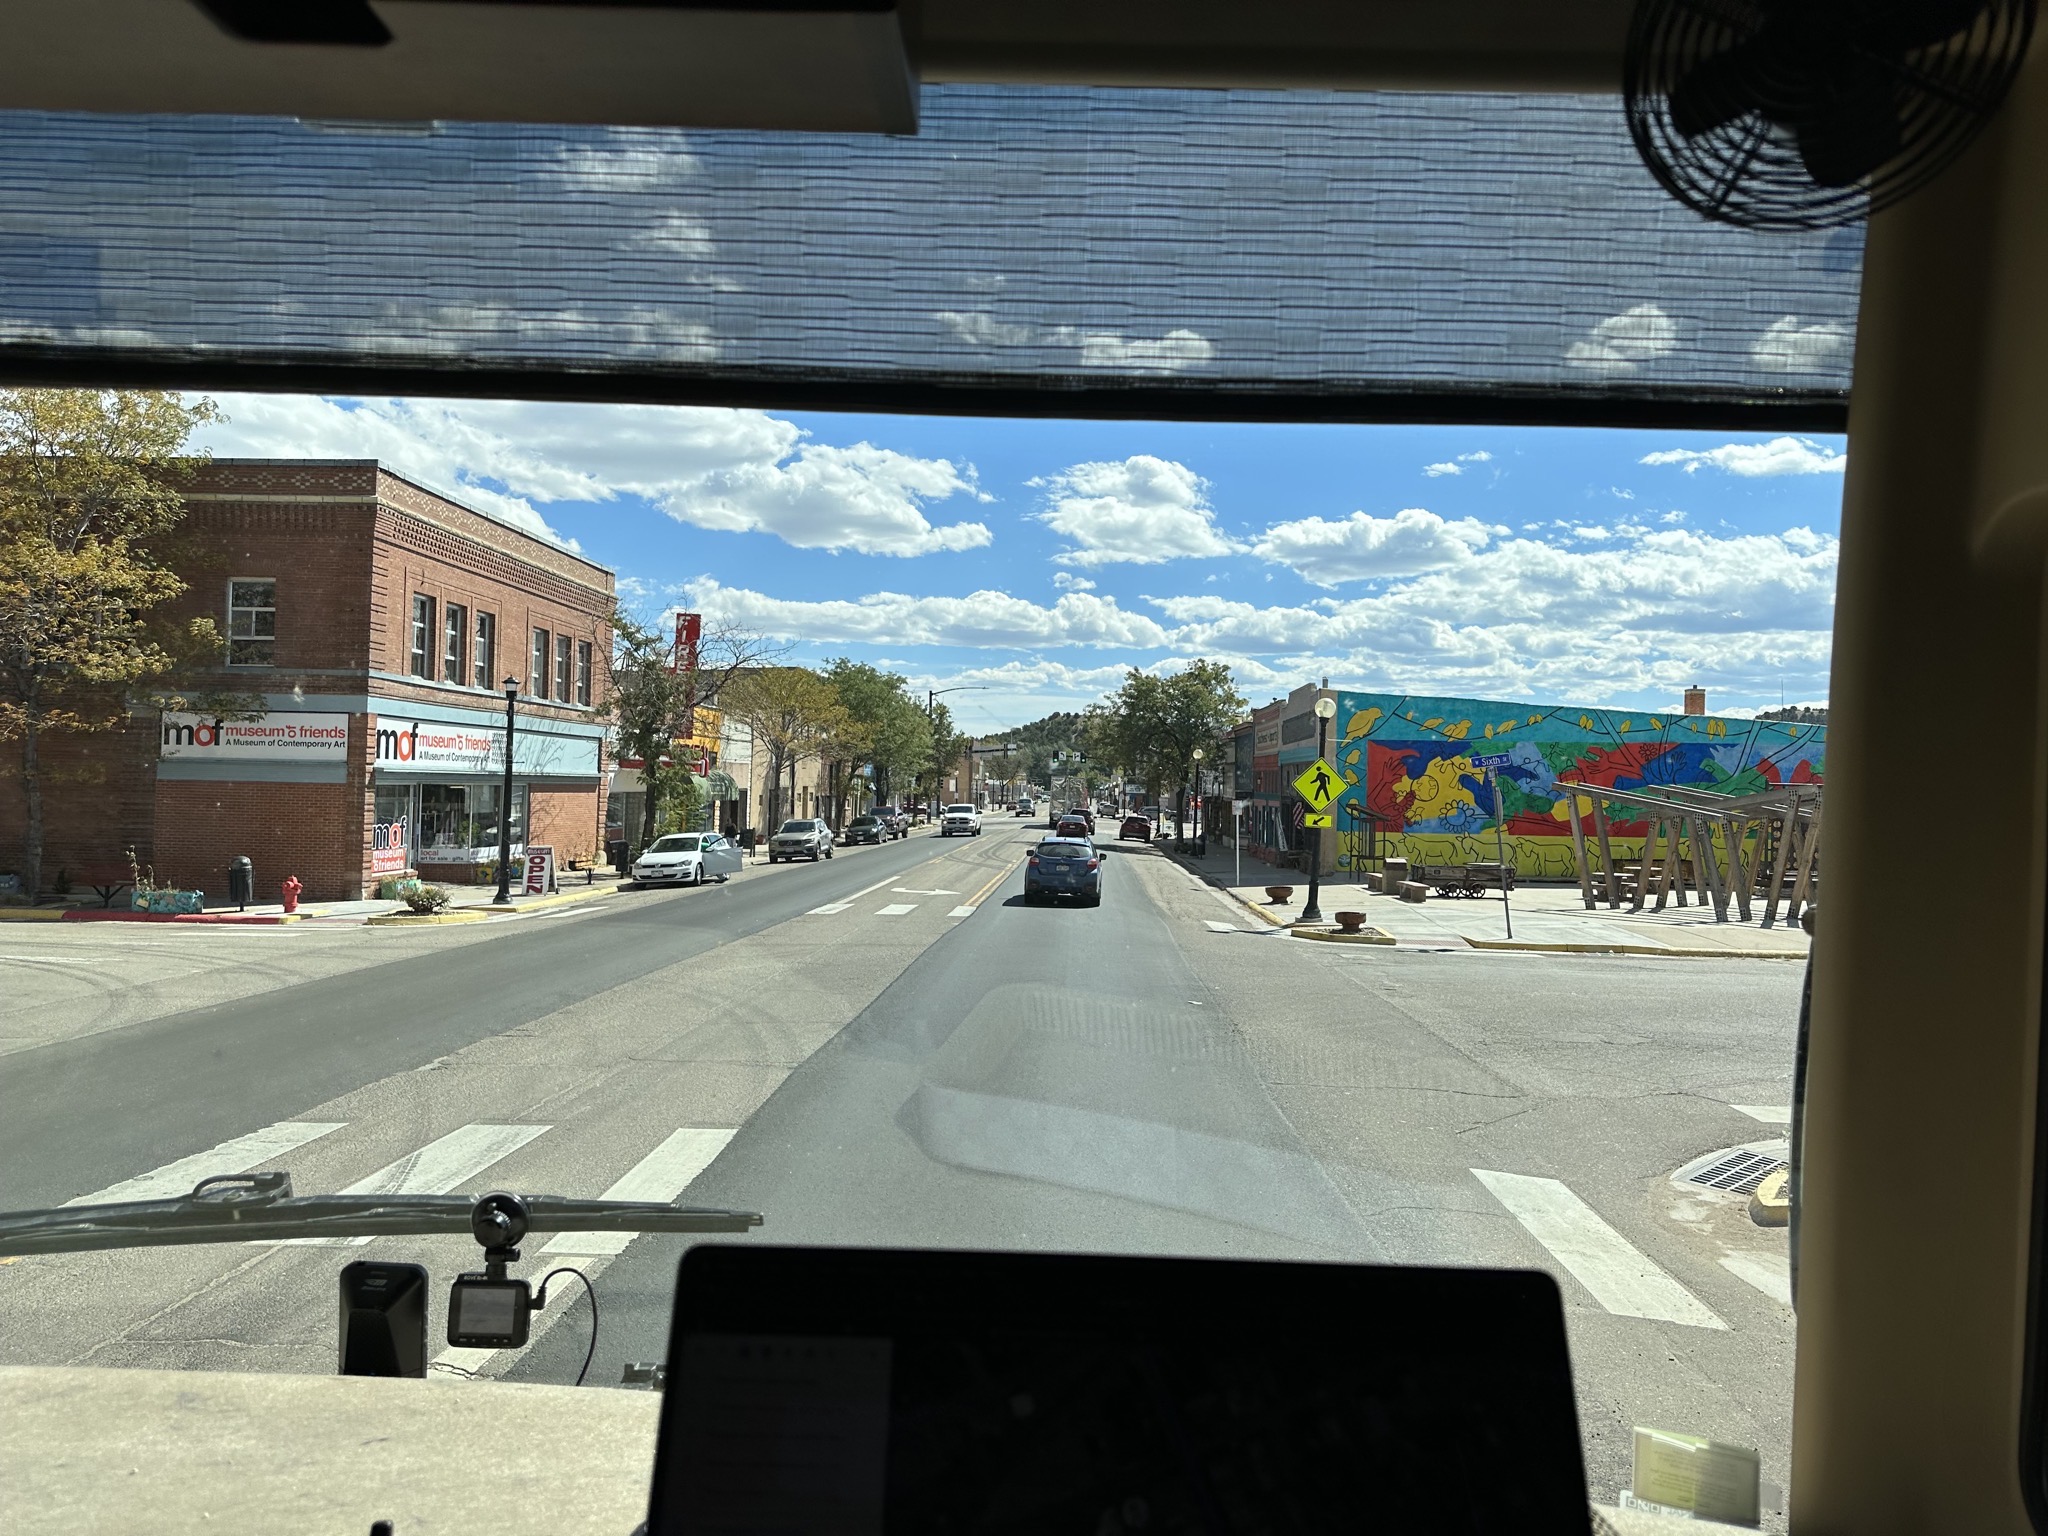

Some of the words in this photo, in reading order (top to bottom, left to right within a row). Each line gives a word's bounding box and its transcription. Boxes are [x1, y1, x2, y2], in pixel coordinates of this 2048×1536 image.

[164, 719, 224, 747] mof
[225, 726, 285, 738] museum
[286, 725, 297, 738] of
[299, 725, 346, 739] friends
[233, 739, 266, 747] Museum
[267, 739, 275, 747] of
[277, 740, 332, 749] Contemporary
[376, 722, 419, 762] mof
[419, 734, 457, 749] museum
[457, 733, 464, 750] of
[465, 734, 491, 751] friends
[419, 752, 424, 760] A
[424, 752, 445, 761] Museum
[446, 753, 451, 761] of
[451, 753, 484, 763] Contemporary
[1482, 756, 1500, 766] Sixth
[371, 815, 407, 850] mof
[373, 849, 404, 860] museum
[379, 859, 404, 870] friends
[526, 855, 546, 894] OPEN
